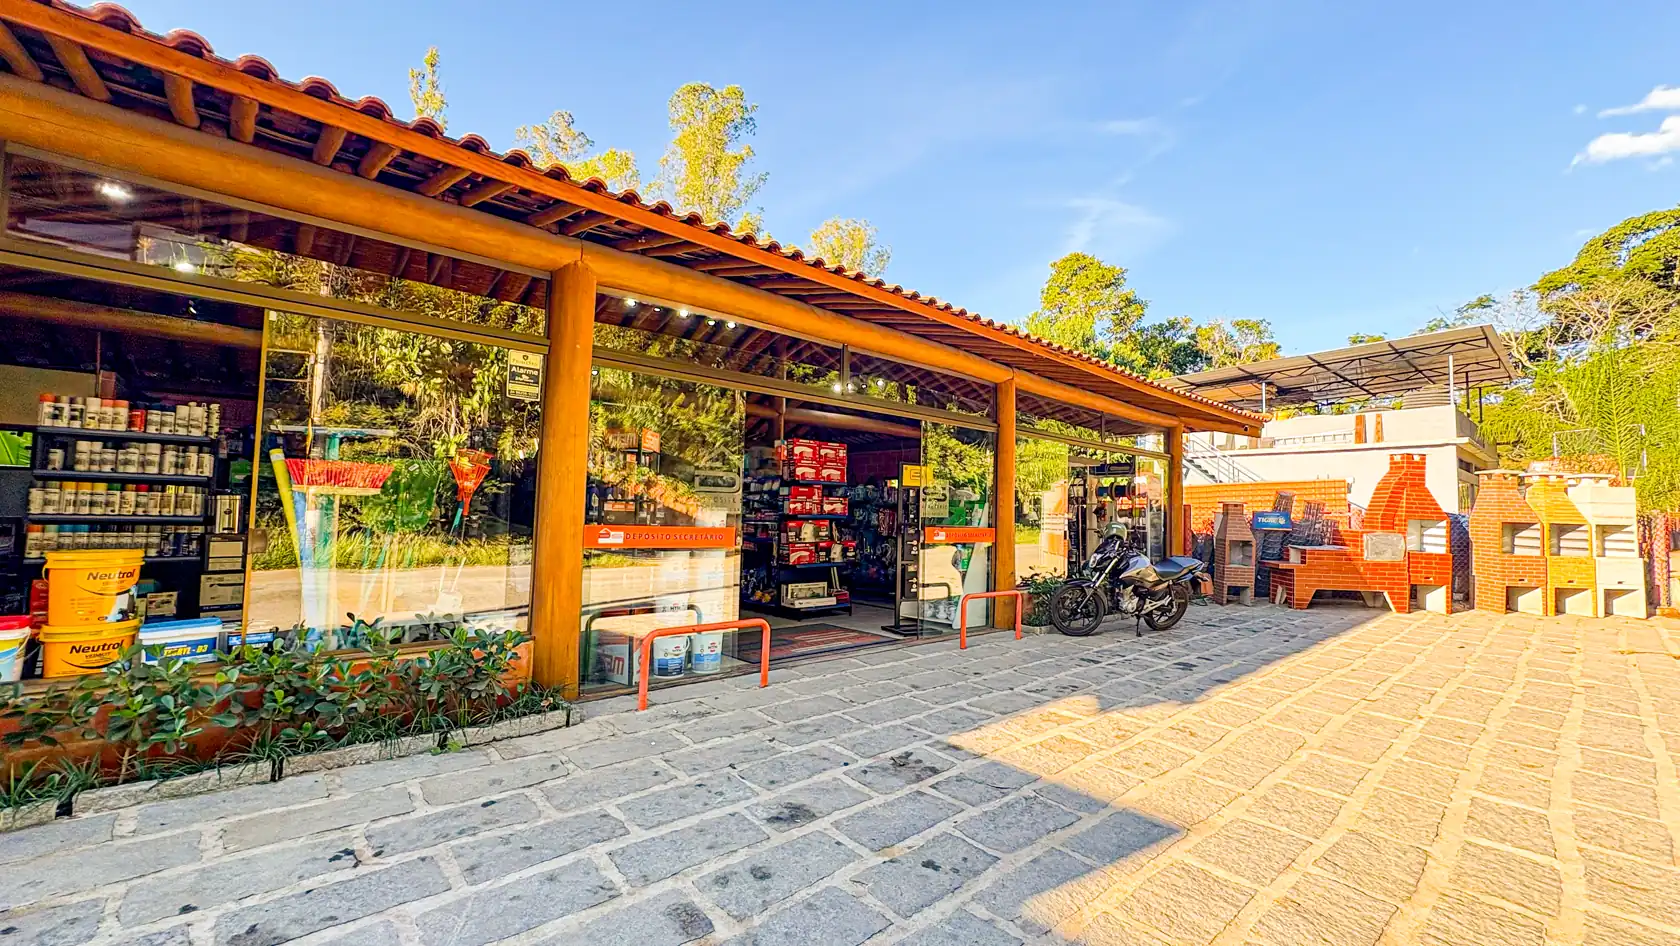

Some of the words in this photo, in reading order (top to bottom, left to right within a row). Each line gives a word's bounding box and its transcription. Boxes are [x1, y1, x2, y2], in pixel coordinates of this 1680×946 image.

[511, 366, 539, 375] Alarme
[87, 569, 136, 580] Neutrol
[69, 640, 124, 654] Neutrol
